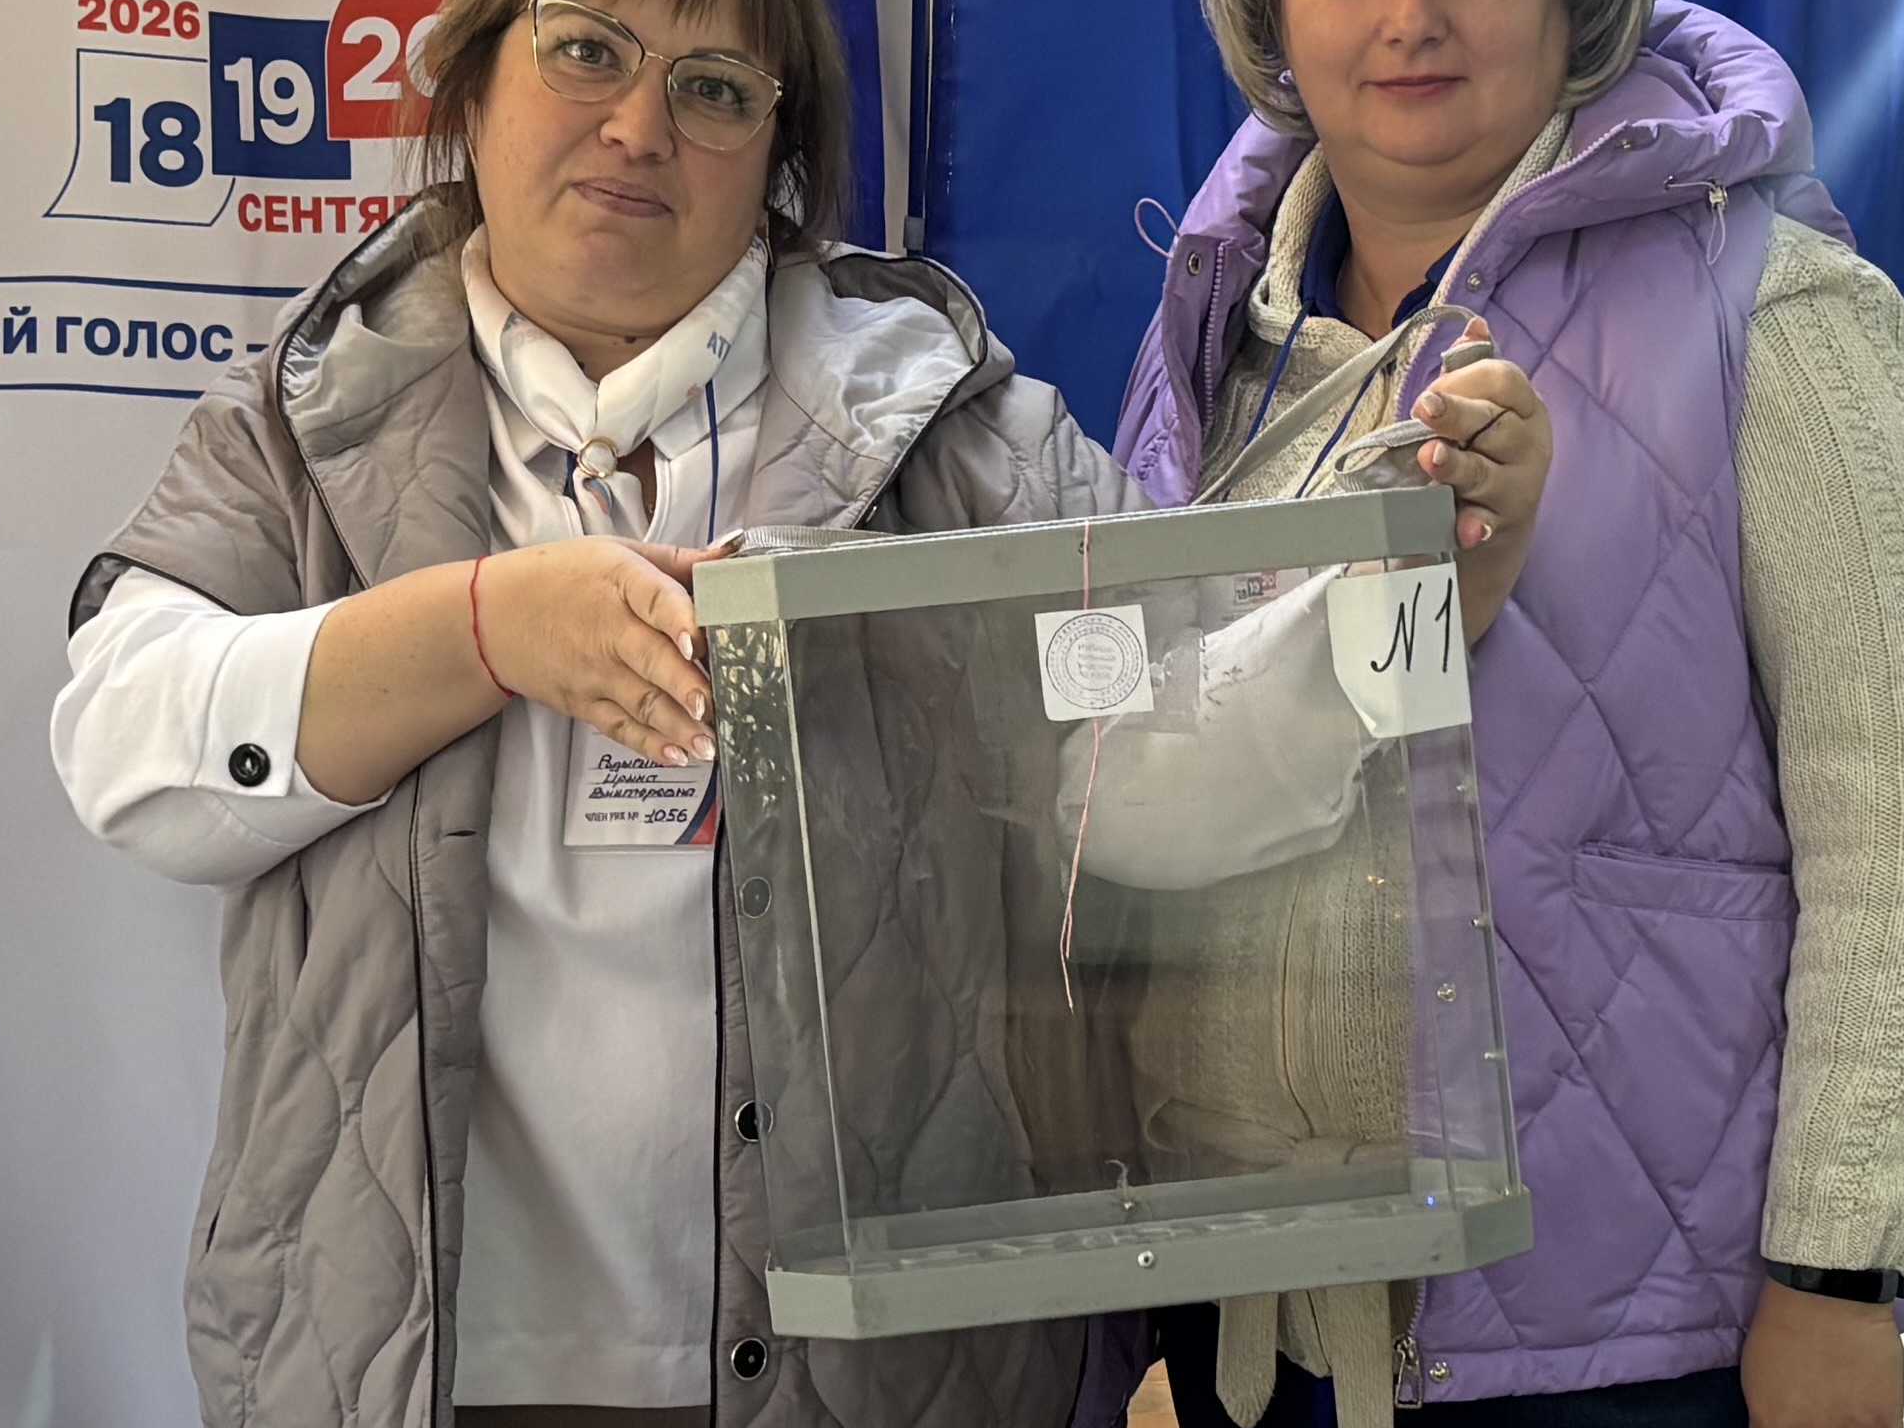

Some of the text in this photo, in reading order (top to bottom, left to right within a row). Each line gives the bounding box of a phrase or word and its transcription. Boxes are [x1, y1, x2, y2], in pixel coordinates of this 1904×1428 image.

[94, 98, 203, 187] 18
[224, 58, 314, 144] 19
[56, 317, 233, 362] ГОЛОС
[644, 809, 688, 823] 1056
